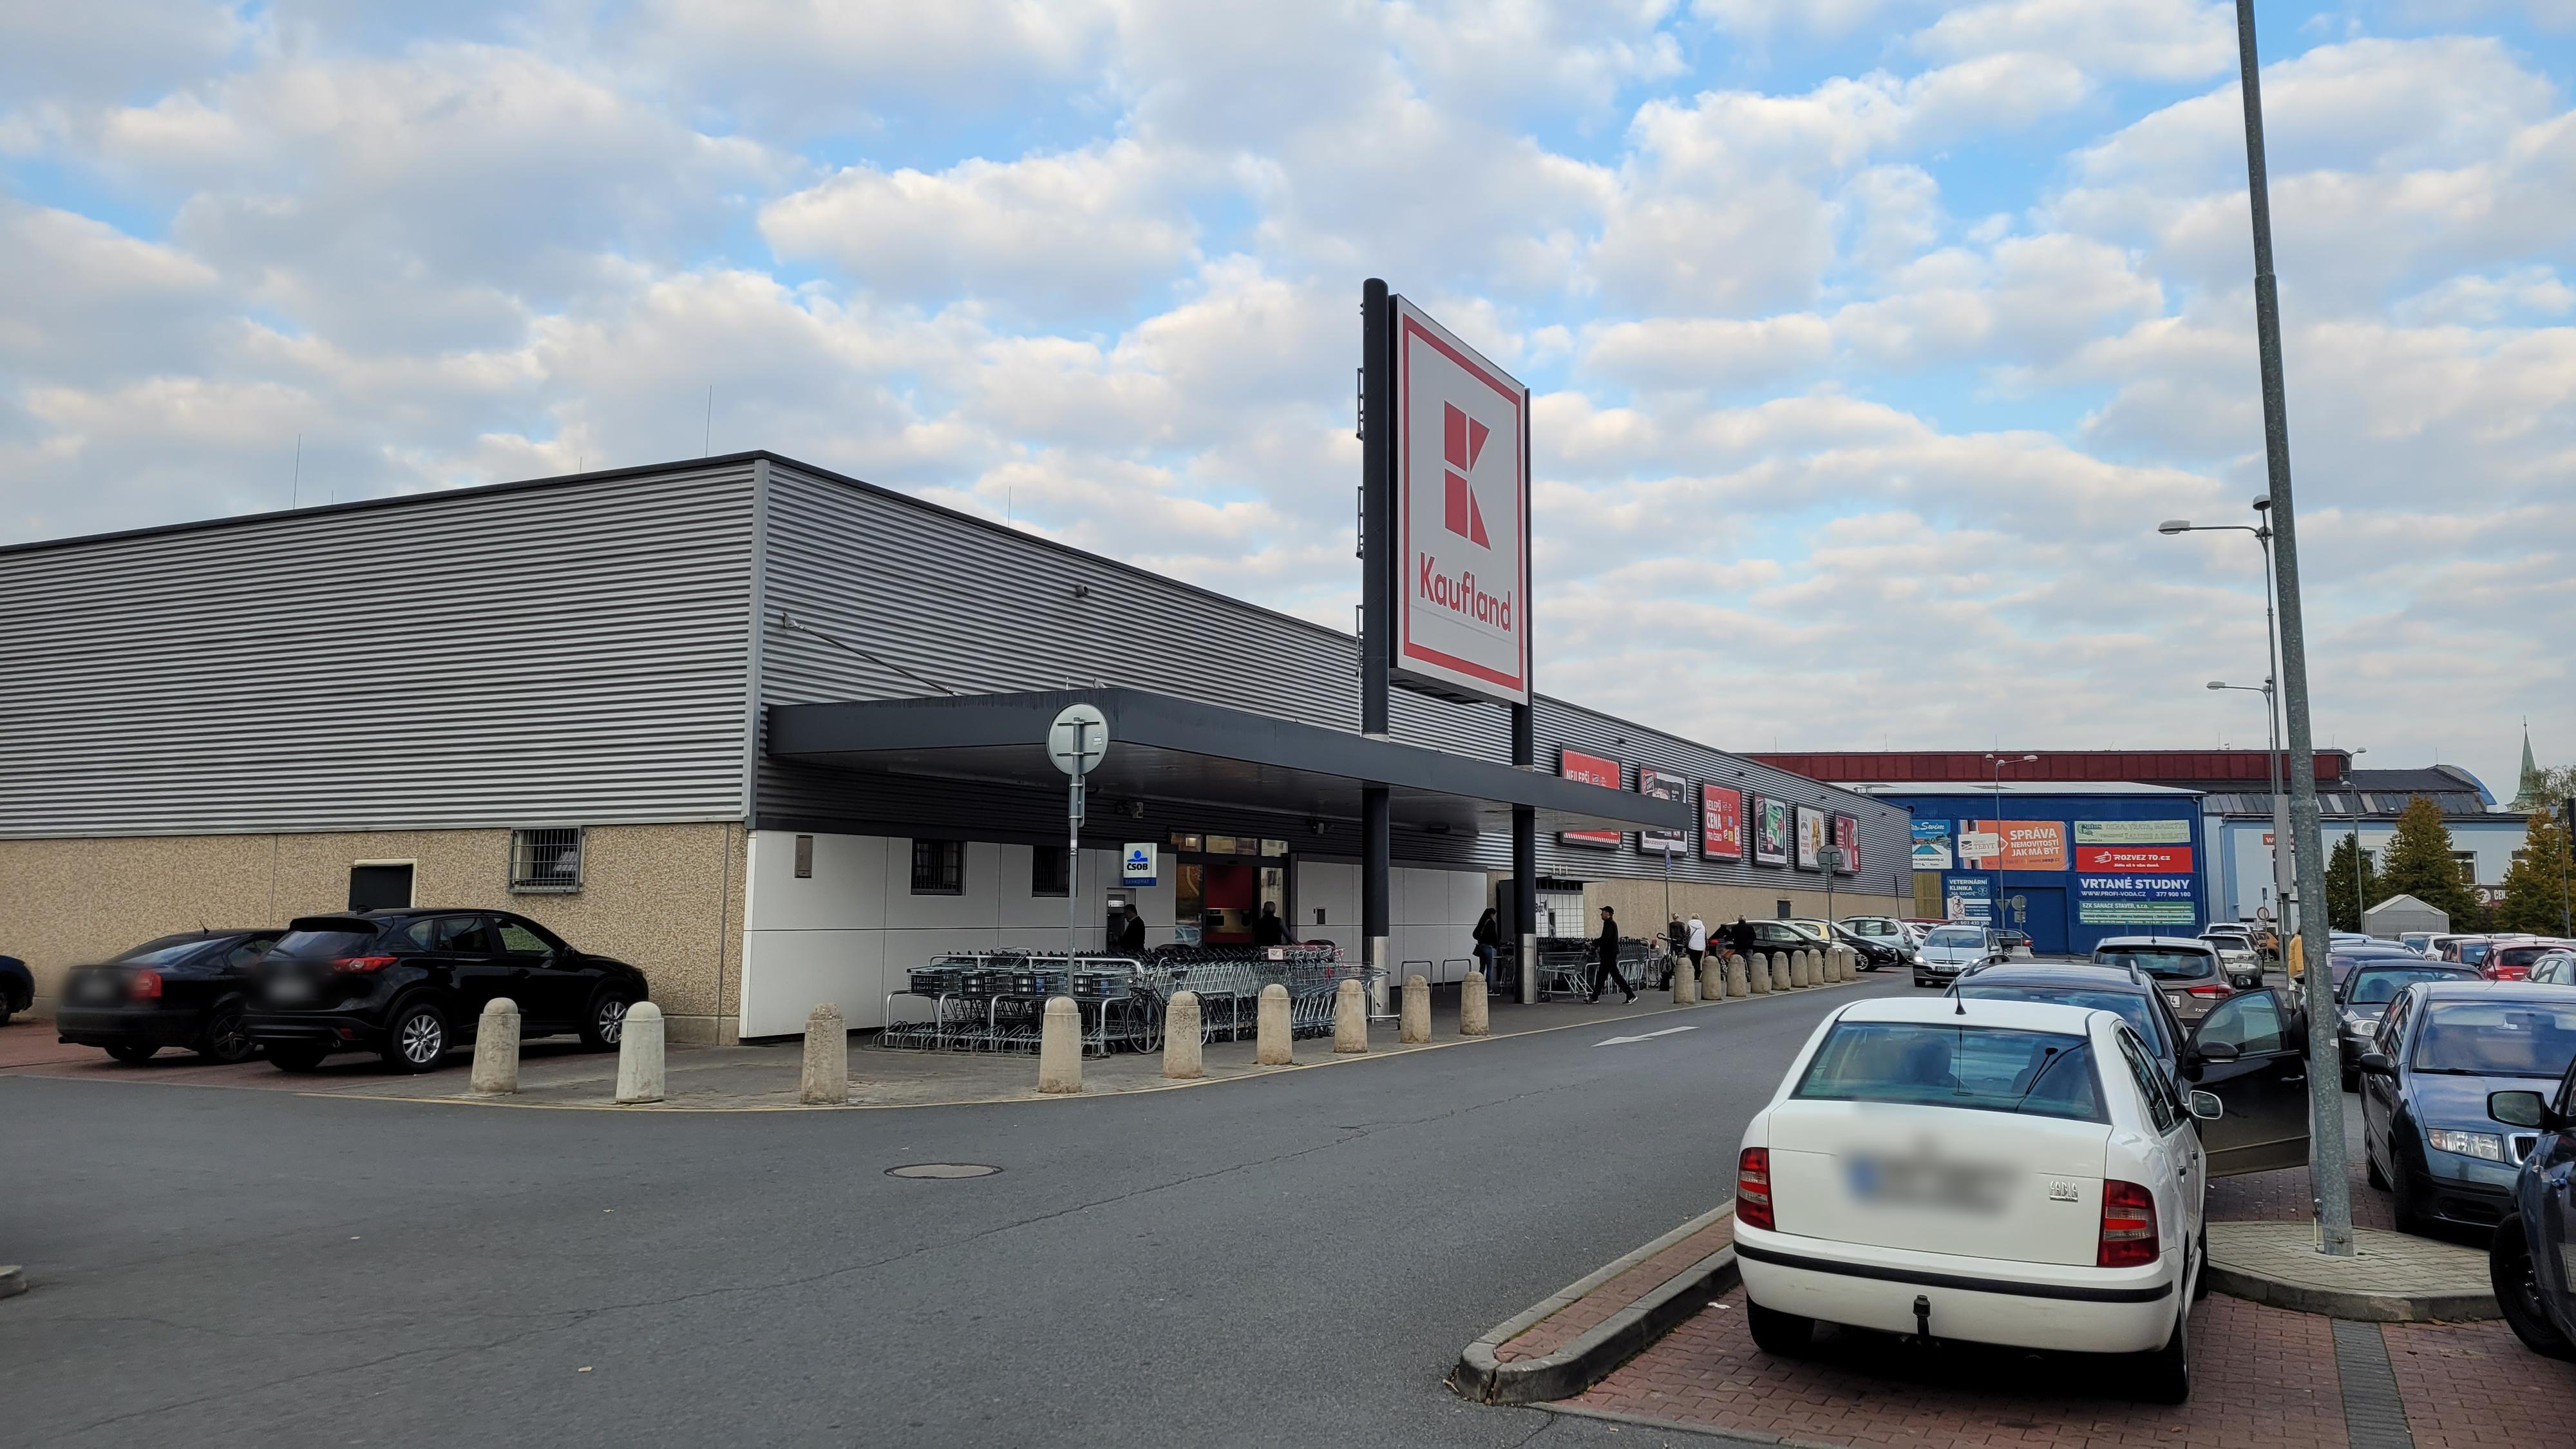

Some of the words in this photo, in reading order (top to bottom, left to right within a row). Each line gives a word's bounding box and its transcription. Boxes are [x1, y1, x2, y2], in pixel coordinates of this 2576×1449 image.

[1420, 551, 1511, 632] Kaufland
[1566, 769, 1589, 783] NEJLEPŠÍ
[1706, 799, 1721, 811] NEJLEPŠÍ
[1707, 812, 1722, 830] CENA
[1920, 822, 1945, 830] Swim
[2010, 827, 2058, 840] SPRÁVA
[2011, 838, 2059, 848] NEMOVITOSTÍ
[2029, 847, 2043, 856] MÁ
[2044, 846, 2060, 855] BÝT
[1126, 862, 1148, 871] ČSOB
[2081, 876, 2133, 889] VRTANÉ
[2135, 879, 2190, 889] STUDNY
[2494, 889, 2508, 900] CEN
[2050, 1180, 2078, 1197] FABIA
